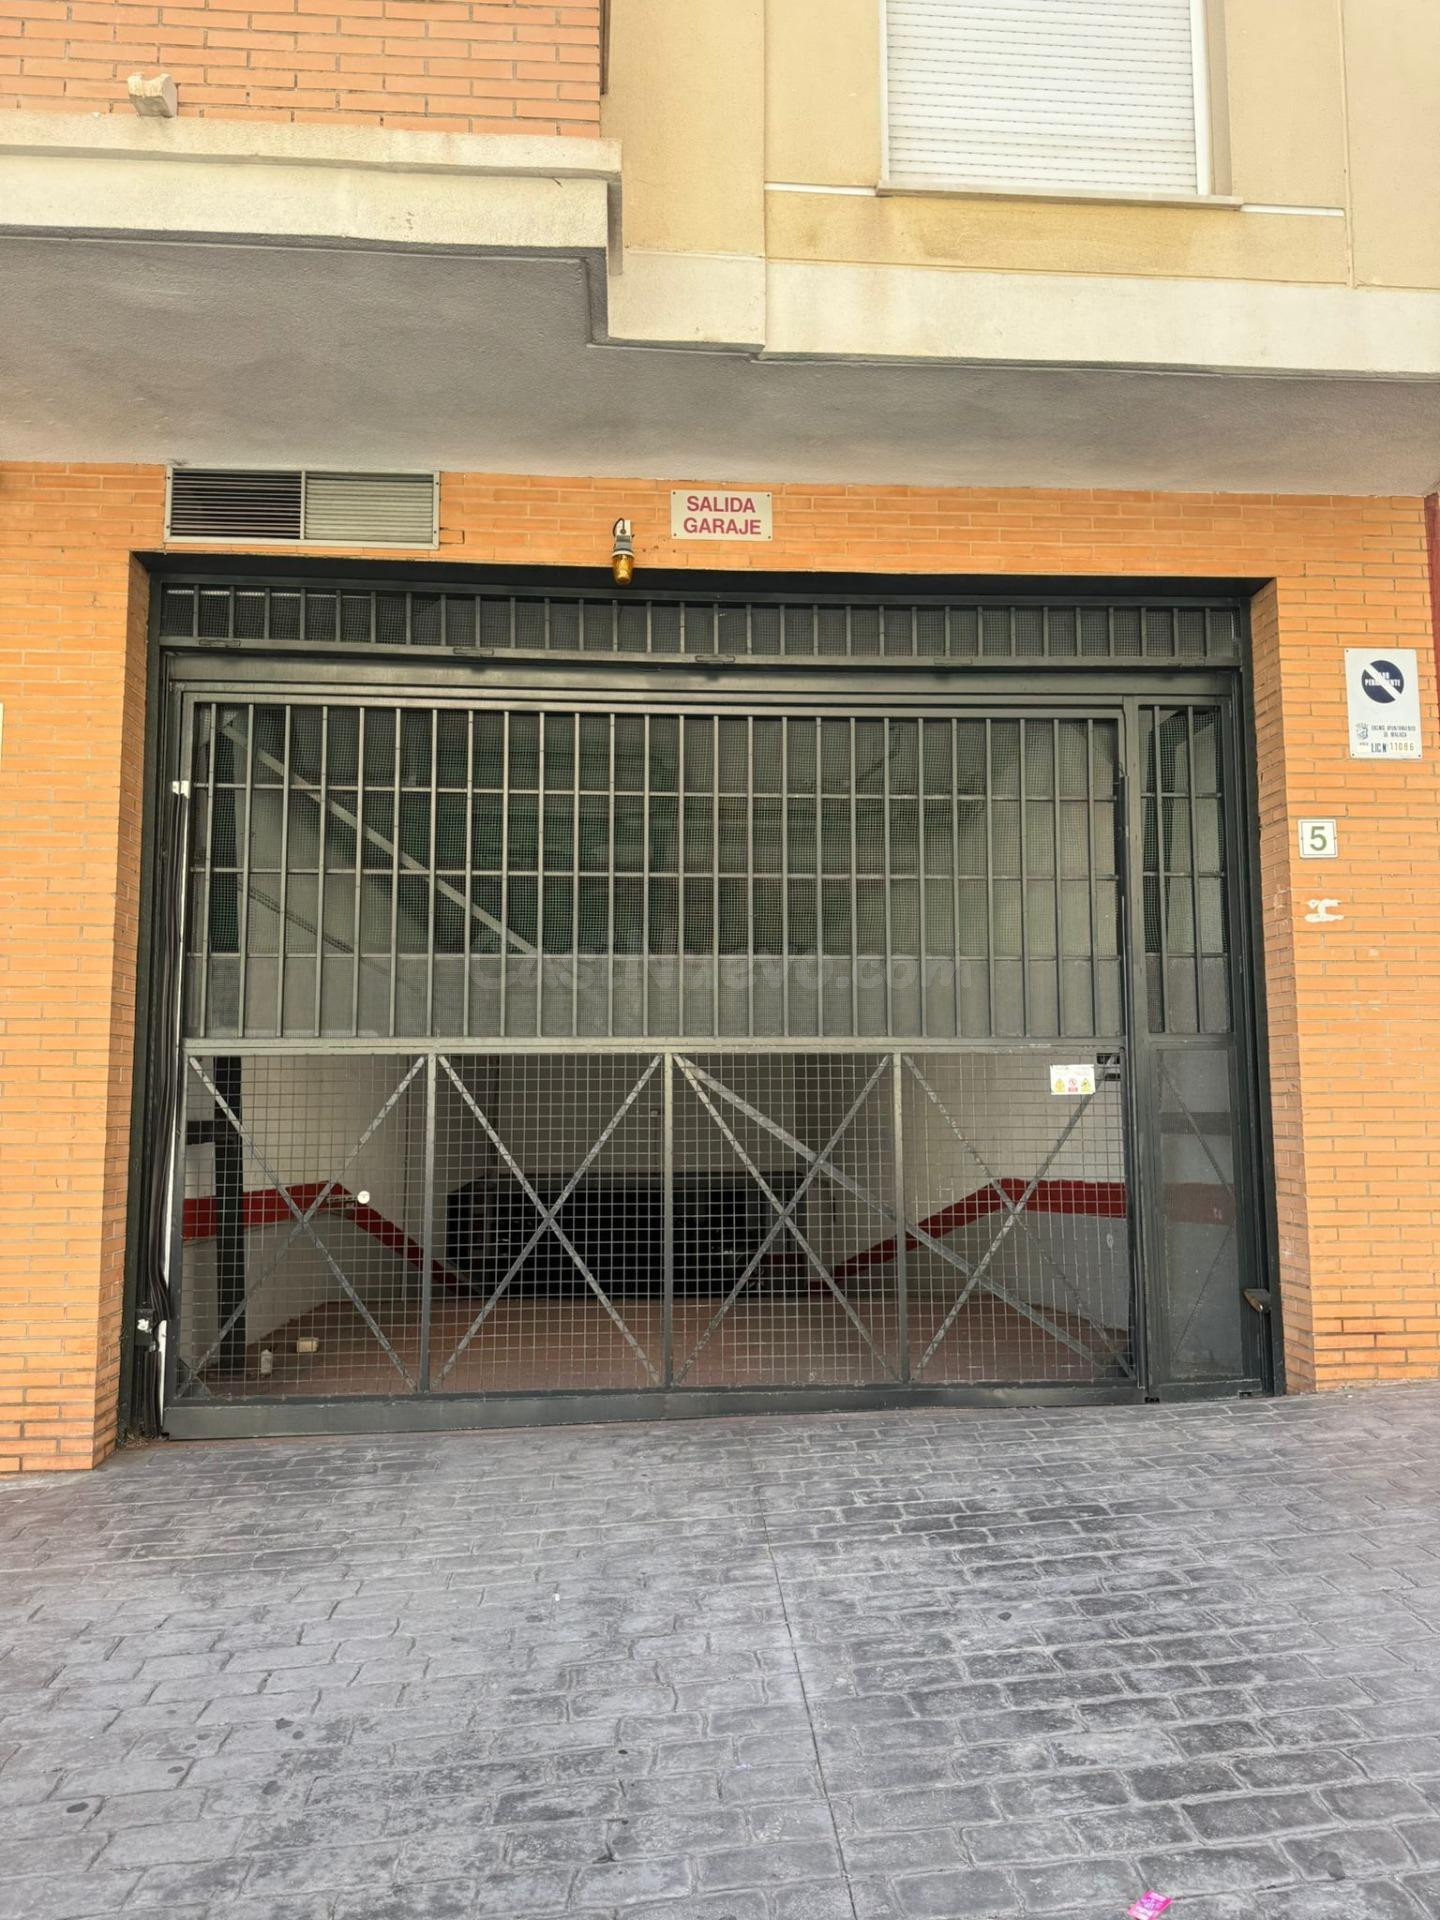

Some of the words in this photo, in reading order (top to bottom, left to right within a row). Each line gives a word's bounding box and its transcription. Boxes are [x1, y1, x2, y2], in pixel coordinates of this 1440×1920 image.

[686, 495, 756, 513] SALIDA
[683, 517, 762, 535] GARAJE
[1310, 826, 1327, 851] 5
